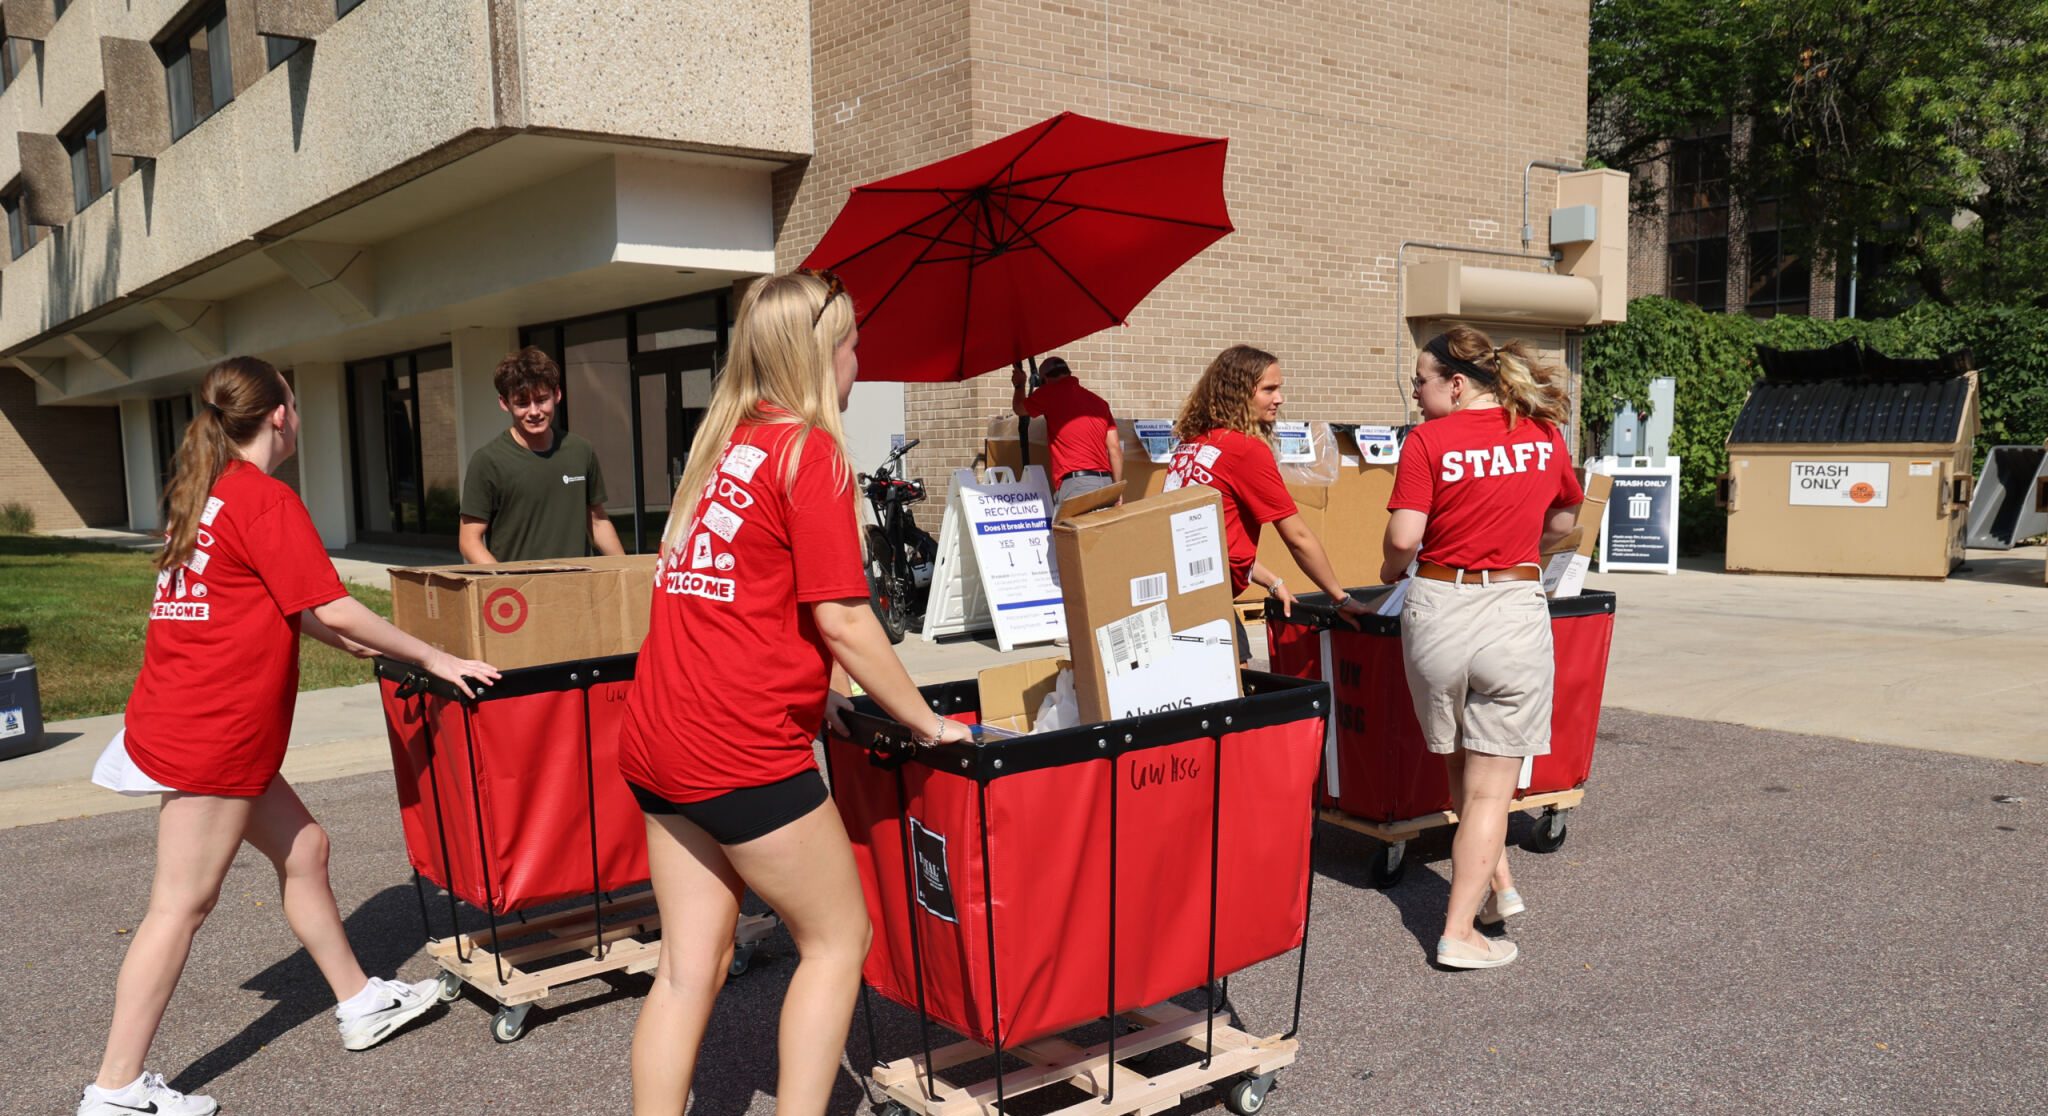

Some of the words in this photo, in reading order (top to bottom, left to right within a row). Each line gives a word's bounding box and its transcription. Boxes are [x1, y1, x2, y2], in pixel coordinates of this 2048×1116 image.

[1442, 441, 1553, 482] STAFF
[1795, 464, 1849, 477] TRASH
[1800, 477, 1841, 490] ONLY
[978, 492, 1039, 505] STYROFOAM
[984, 505, 1039, 517] RECYCLING
[984, 524, 1001, 532] Does
[1007, 522, 1024, 530] break
[1031, 520, 1047, 528] half?
[999, 539, 1015, 548] YES
[1028, 537, 1041, 546] NO
[1130, 759, 1166, 791] UW
[1170, 753, 1201, 783] HSG
